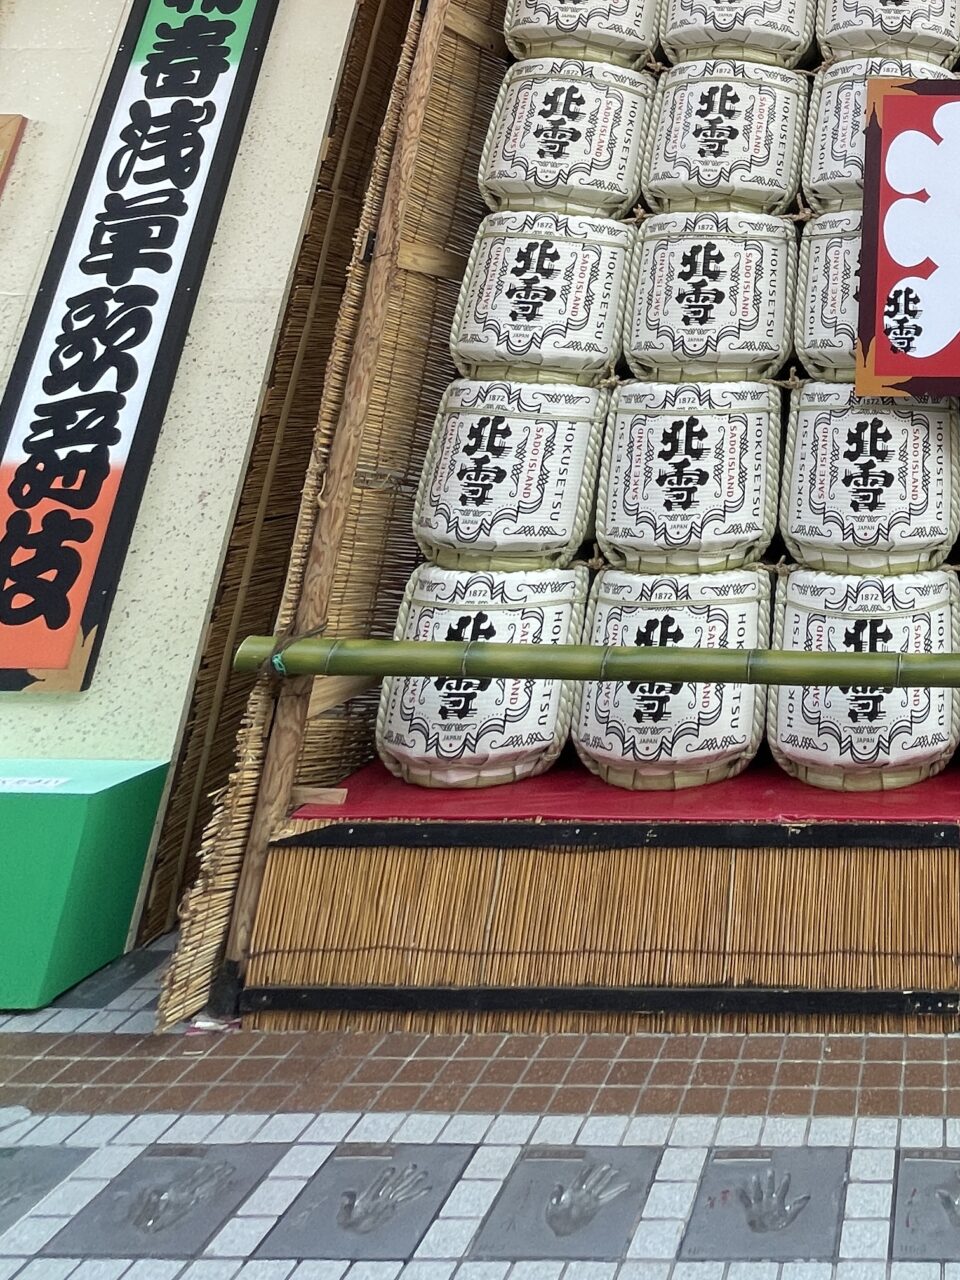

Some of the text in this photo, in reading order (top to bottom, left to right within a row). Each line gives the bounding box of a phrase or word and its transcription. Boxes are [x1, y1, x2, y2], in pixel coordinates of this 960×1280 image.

[533, 85, 587, 160] 北雪
[616, 100, 639, 181] HOKUSETSU
[692, 83, 742, 158] 北雪
[775, 95, 791, 176] HOKUSETSU
[818, 89, 833, 171] HOKUSETSU
[505, 239, 562, 322] 北雪
[593, 250, 619, 340] HOKUSETSU
[675, 241, 728, 326] 北雪
[766, 248, 779, 338] HOKUSETSU
[808, 245, 821, 336] HOKUSETSU
[884, 286, 924, 354] 北雪
[456, 413, 513, 507] 北雪
[548, 420, 577, 522] HOKUSETSU
[656, 416, 711, 512] 北雪
[752, 417, 764, 517] HOKUSETSU
[796, 419, 809, 520] HOKUSETSU
[842, 417, 896, 512] 北雪
[935, 421, 944, 521] HOKUSETSU
